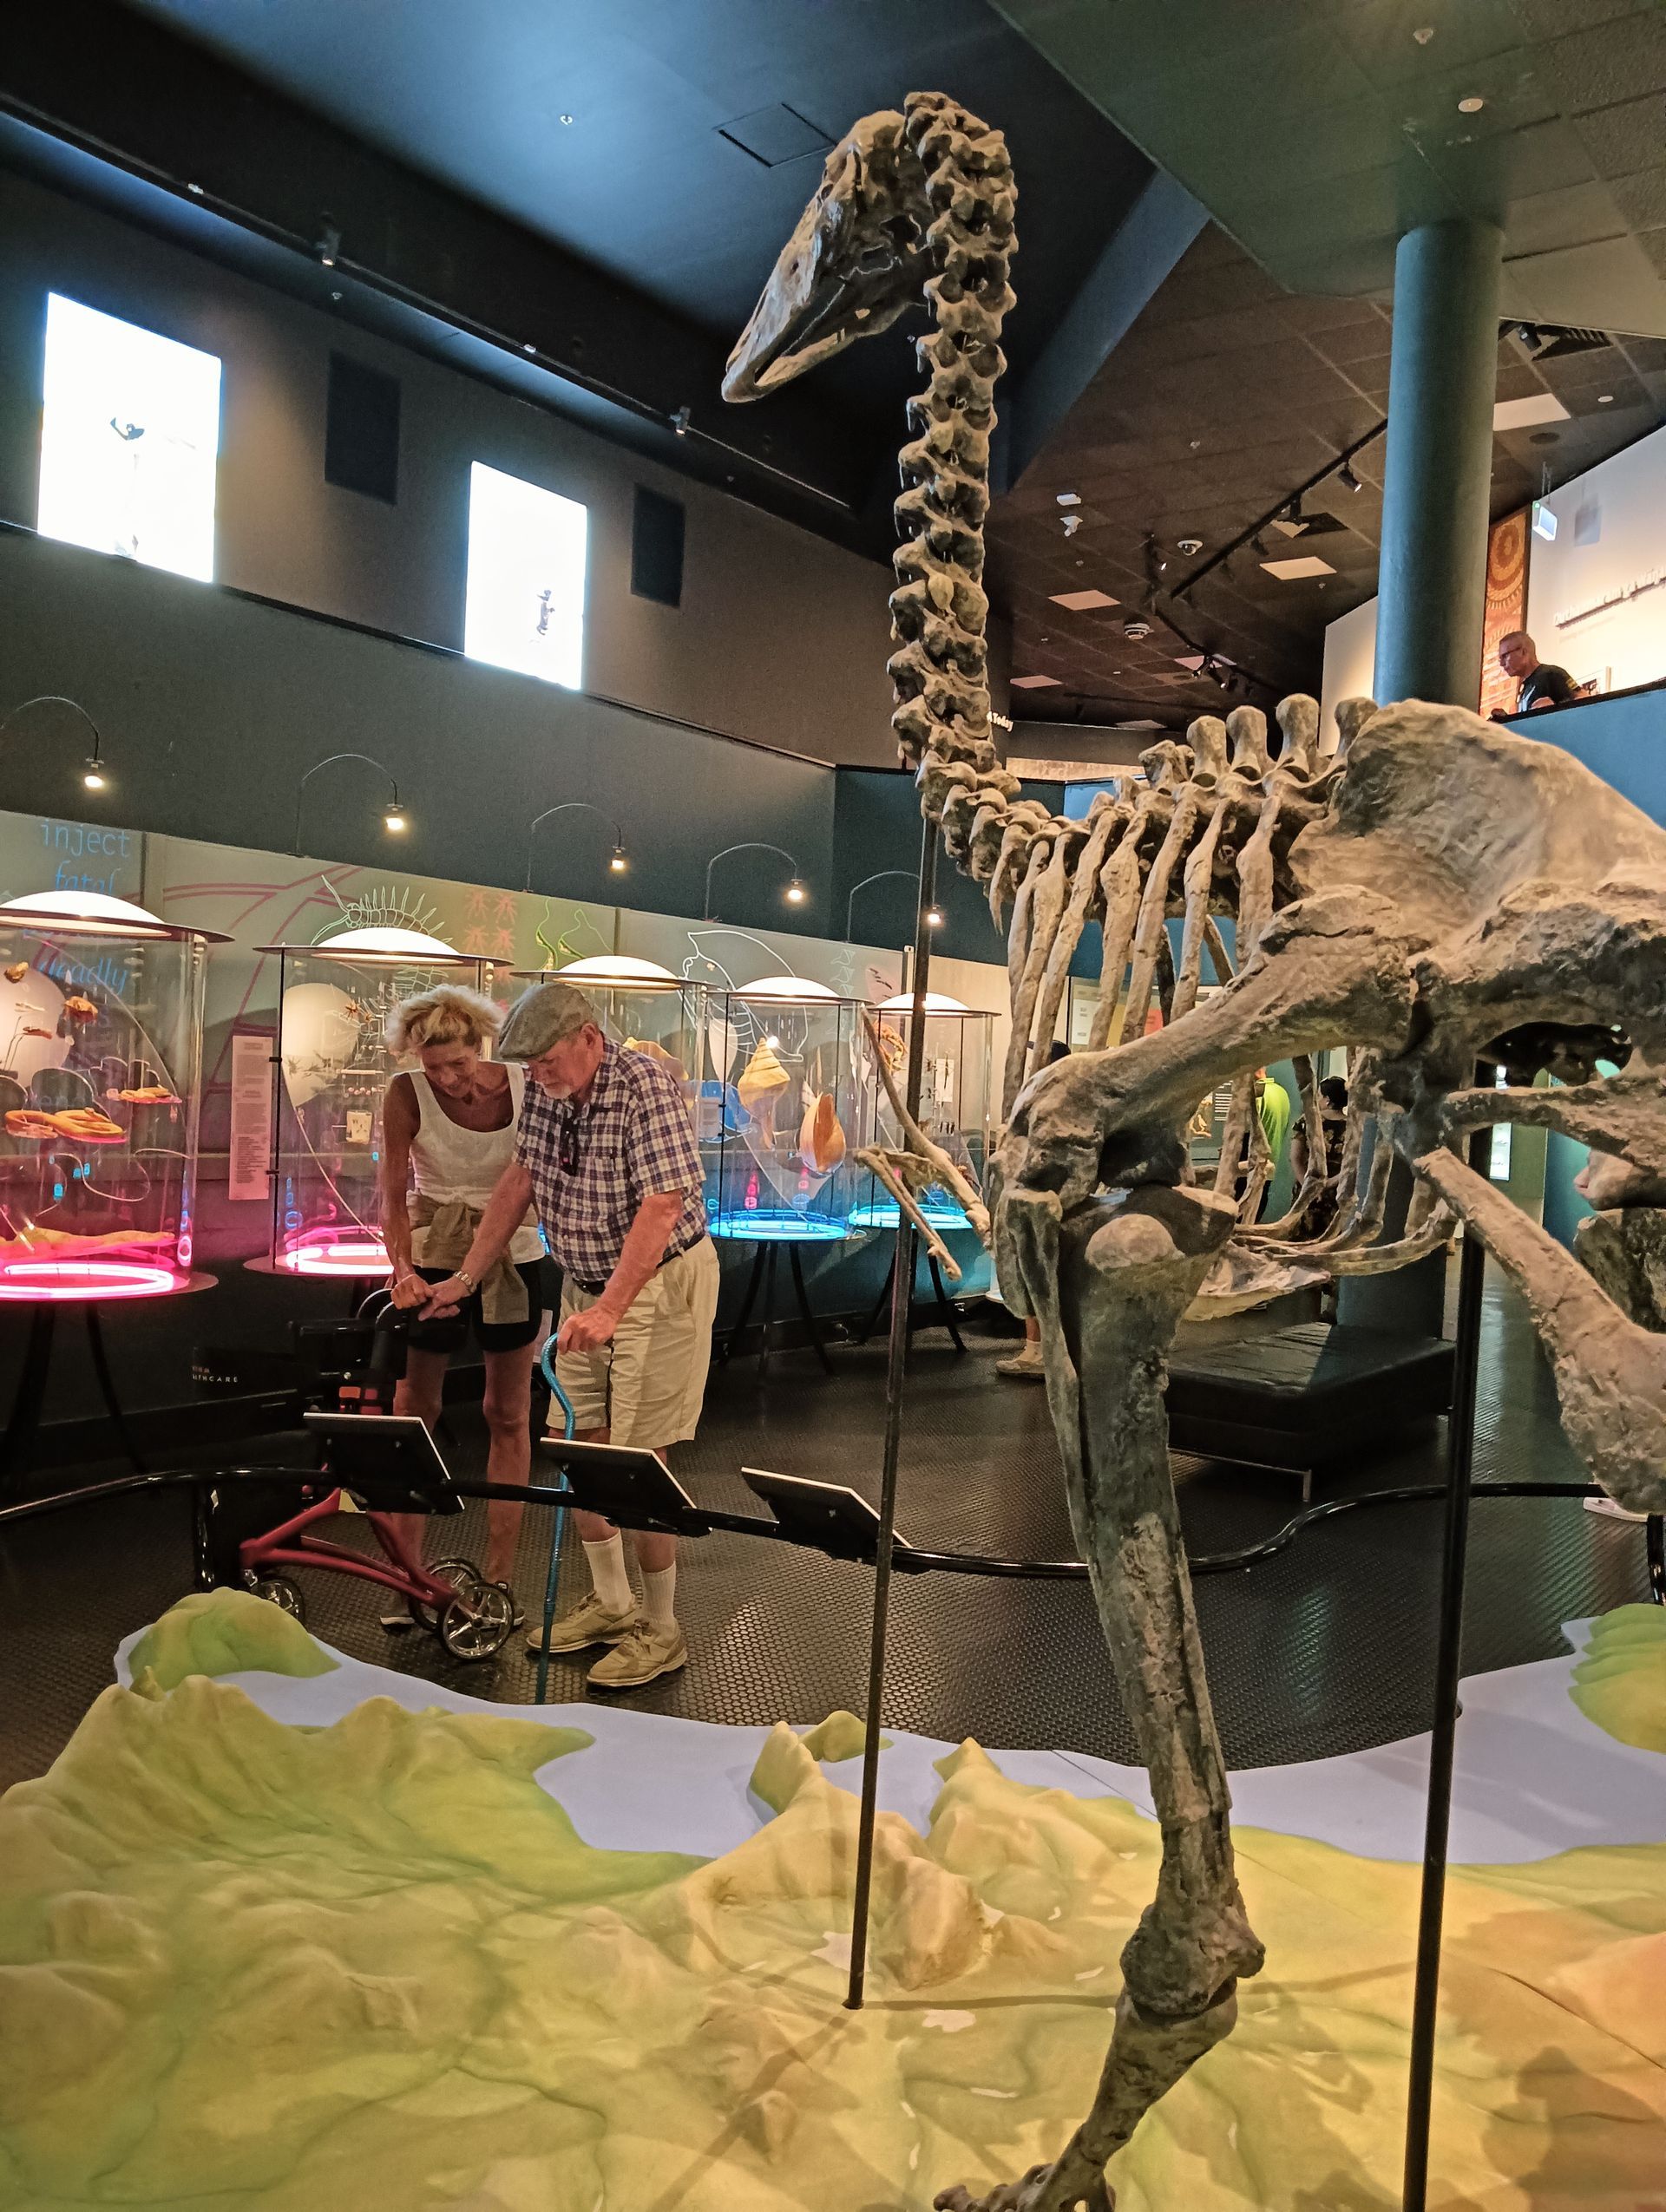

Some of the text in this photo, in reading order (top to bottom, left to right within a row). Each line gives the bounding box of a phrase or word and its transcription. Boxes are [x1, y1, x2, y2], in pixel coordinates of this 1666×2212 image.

[41, 819, 130, 857] inject
[55, 860, 121, 894] fatal
[38, 958, 128, 994] deadly
